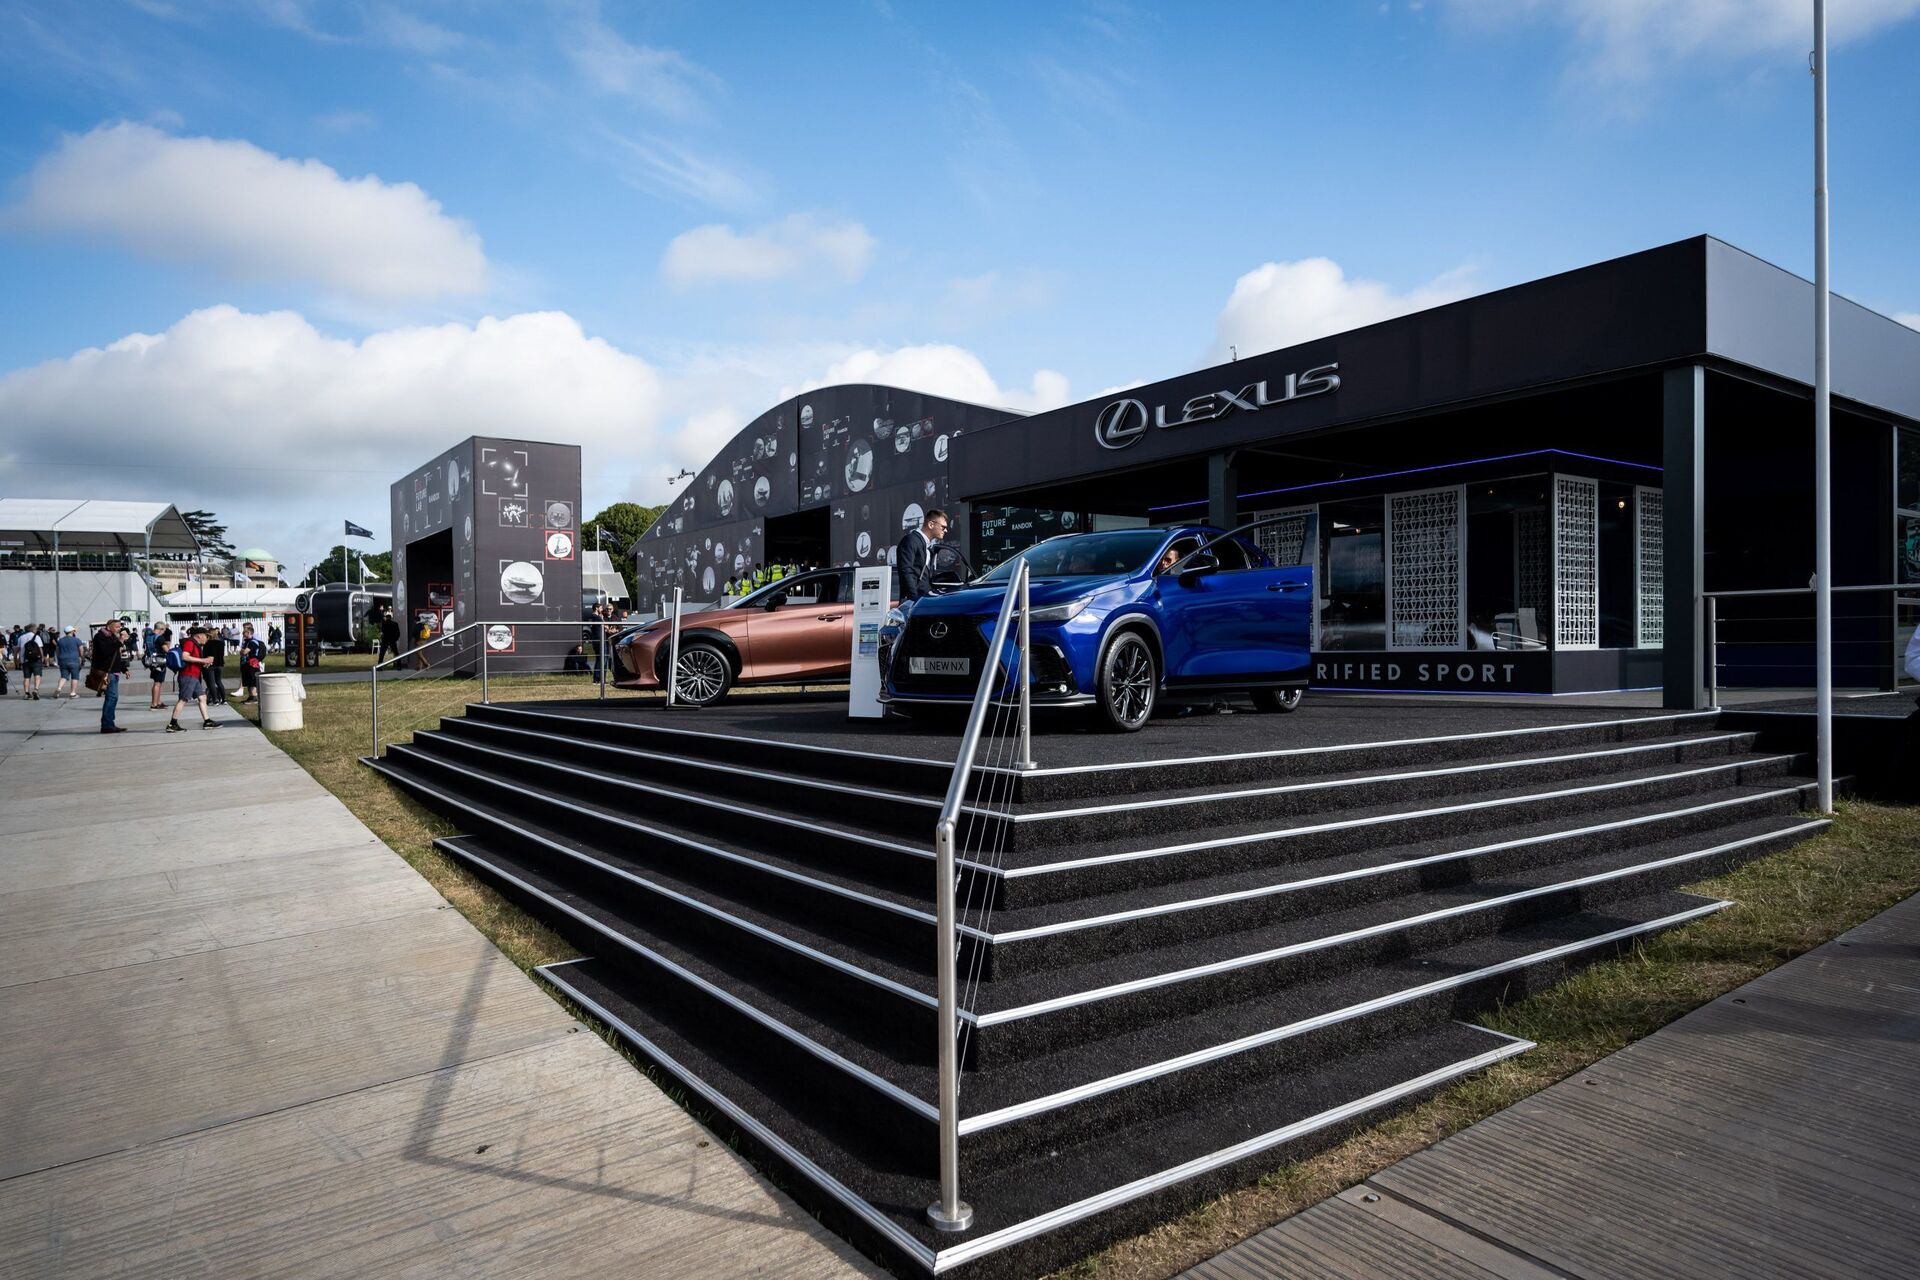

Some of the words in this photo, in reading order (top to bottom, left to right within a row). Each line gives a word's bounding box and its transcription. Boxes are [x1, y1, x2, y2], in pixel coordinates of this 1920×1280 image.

[1155, 361, 1341, 429] LEXUS
[982, 518, 1006, 529] FUTURE
[1011, 521, 1033, 531] RANDOX
[982, 528, 995, 537] LAB
[930, 661, 949, 671] NEW
[951, 661, 965, 672] NX
[1316, 663, 1401, 681] RIFIED
[1418, 663, 1515, 683] SPORT
